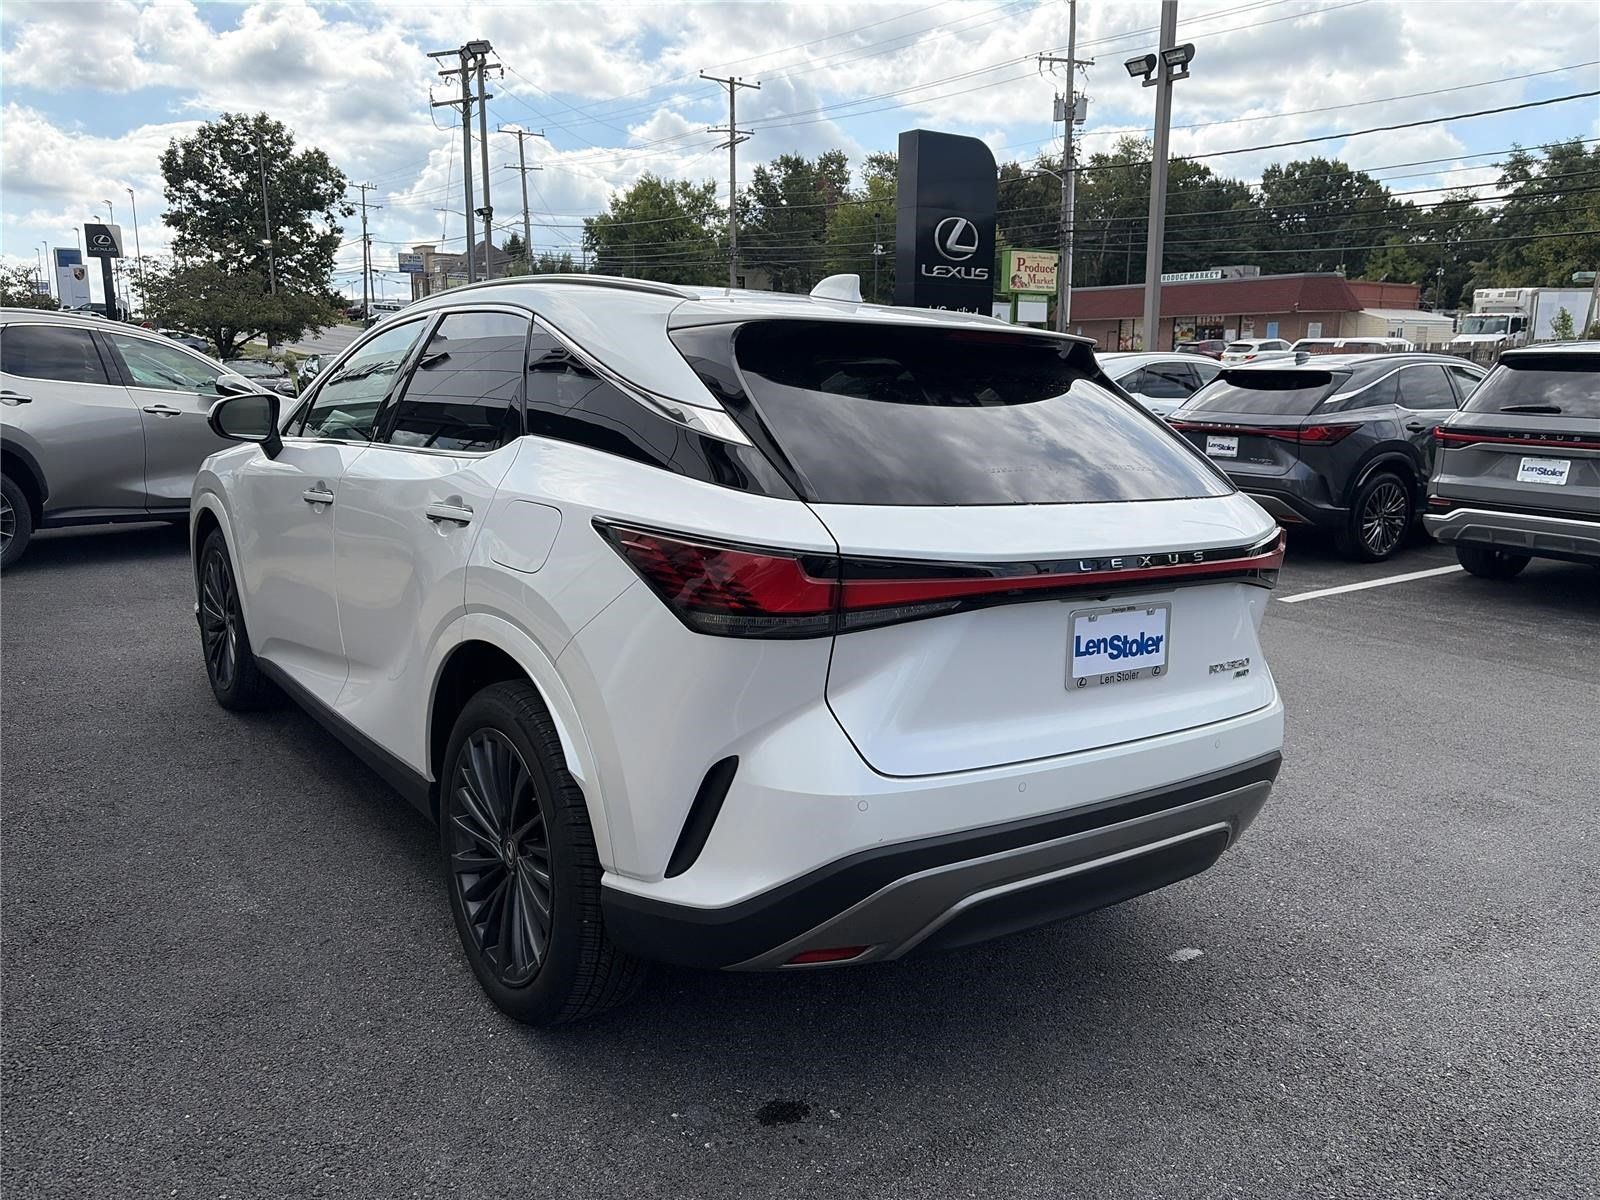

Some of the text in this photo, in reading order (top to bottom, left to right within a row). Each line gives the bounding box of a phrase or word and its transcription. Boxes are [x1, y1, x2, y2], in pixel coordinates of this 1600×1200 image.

[921, 264, 989, 280] LEXUS
[1016, 257, 1056, 273] Produce
[1027, 273, 1055, 286] Market
[1162, 271, 1220, 281] RODUCE MARKET
[1508, 433, 1581, 441] LEXUS
[1079, 551, 1205, 571] LEXUS
[1100, 670, 1140, 684] Len Stoler
